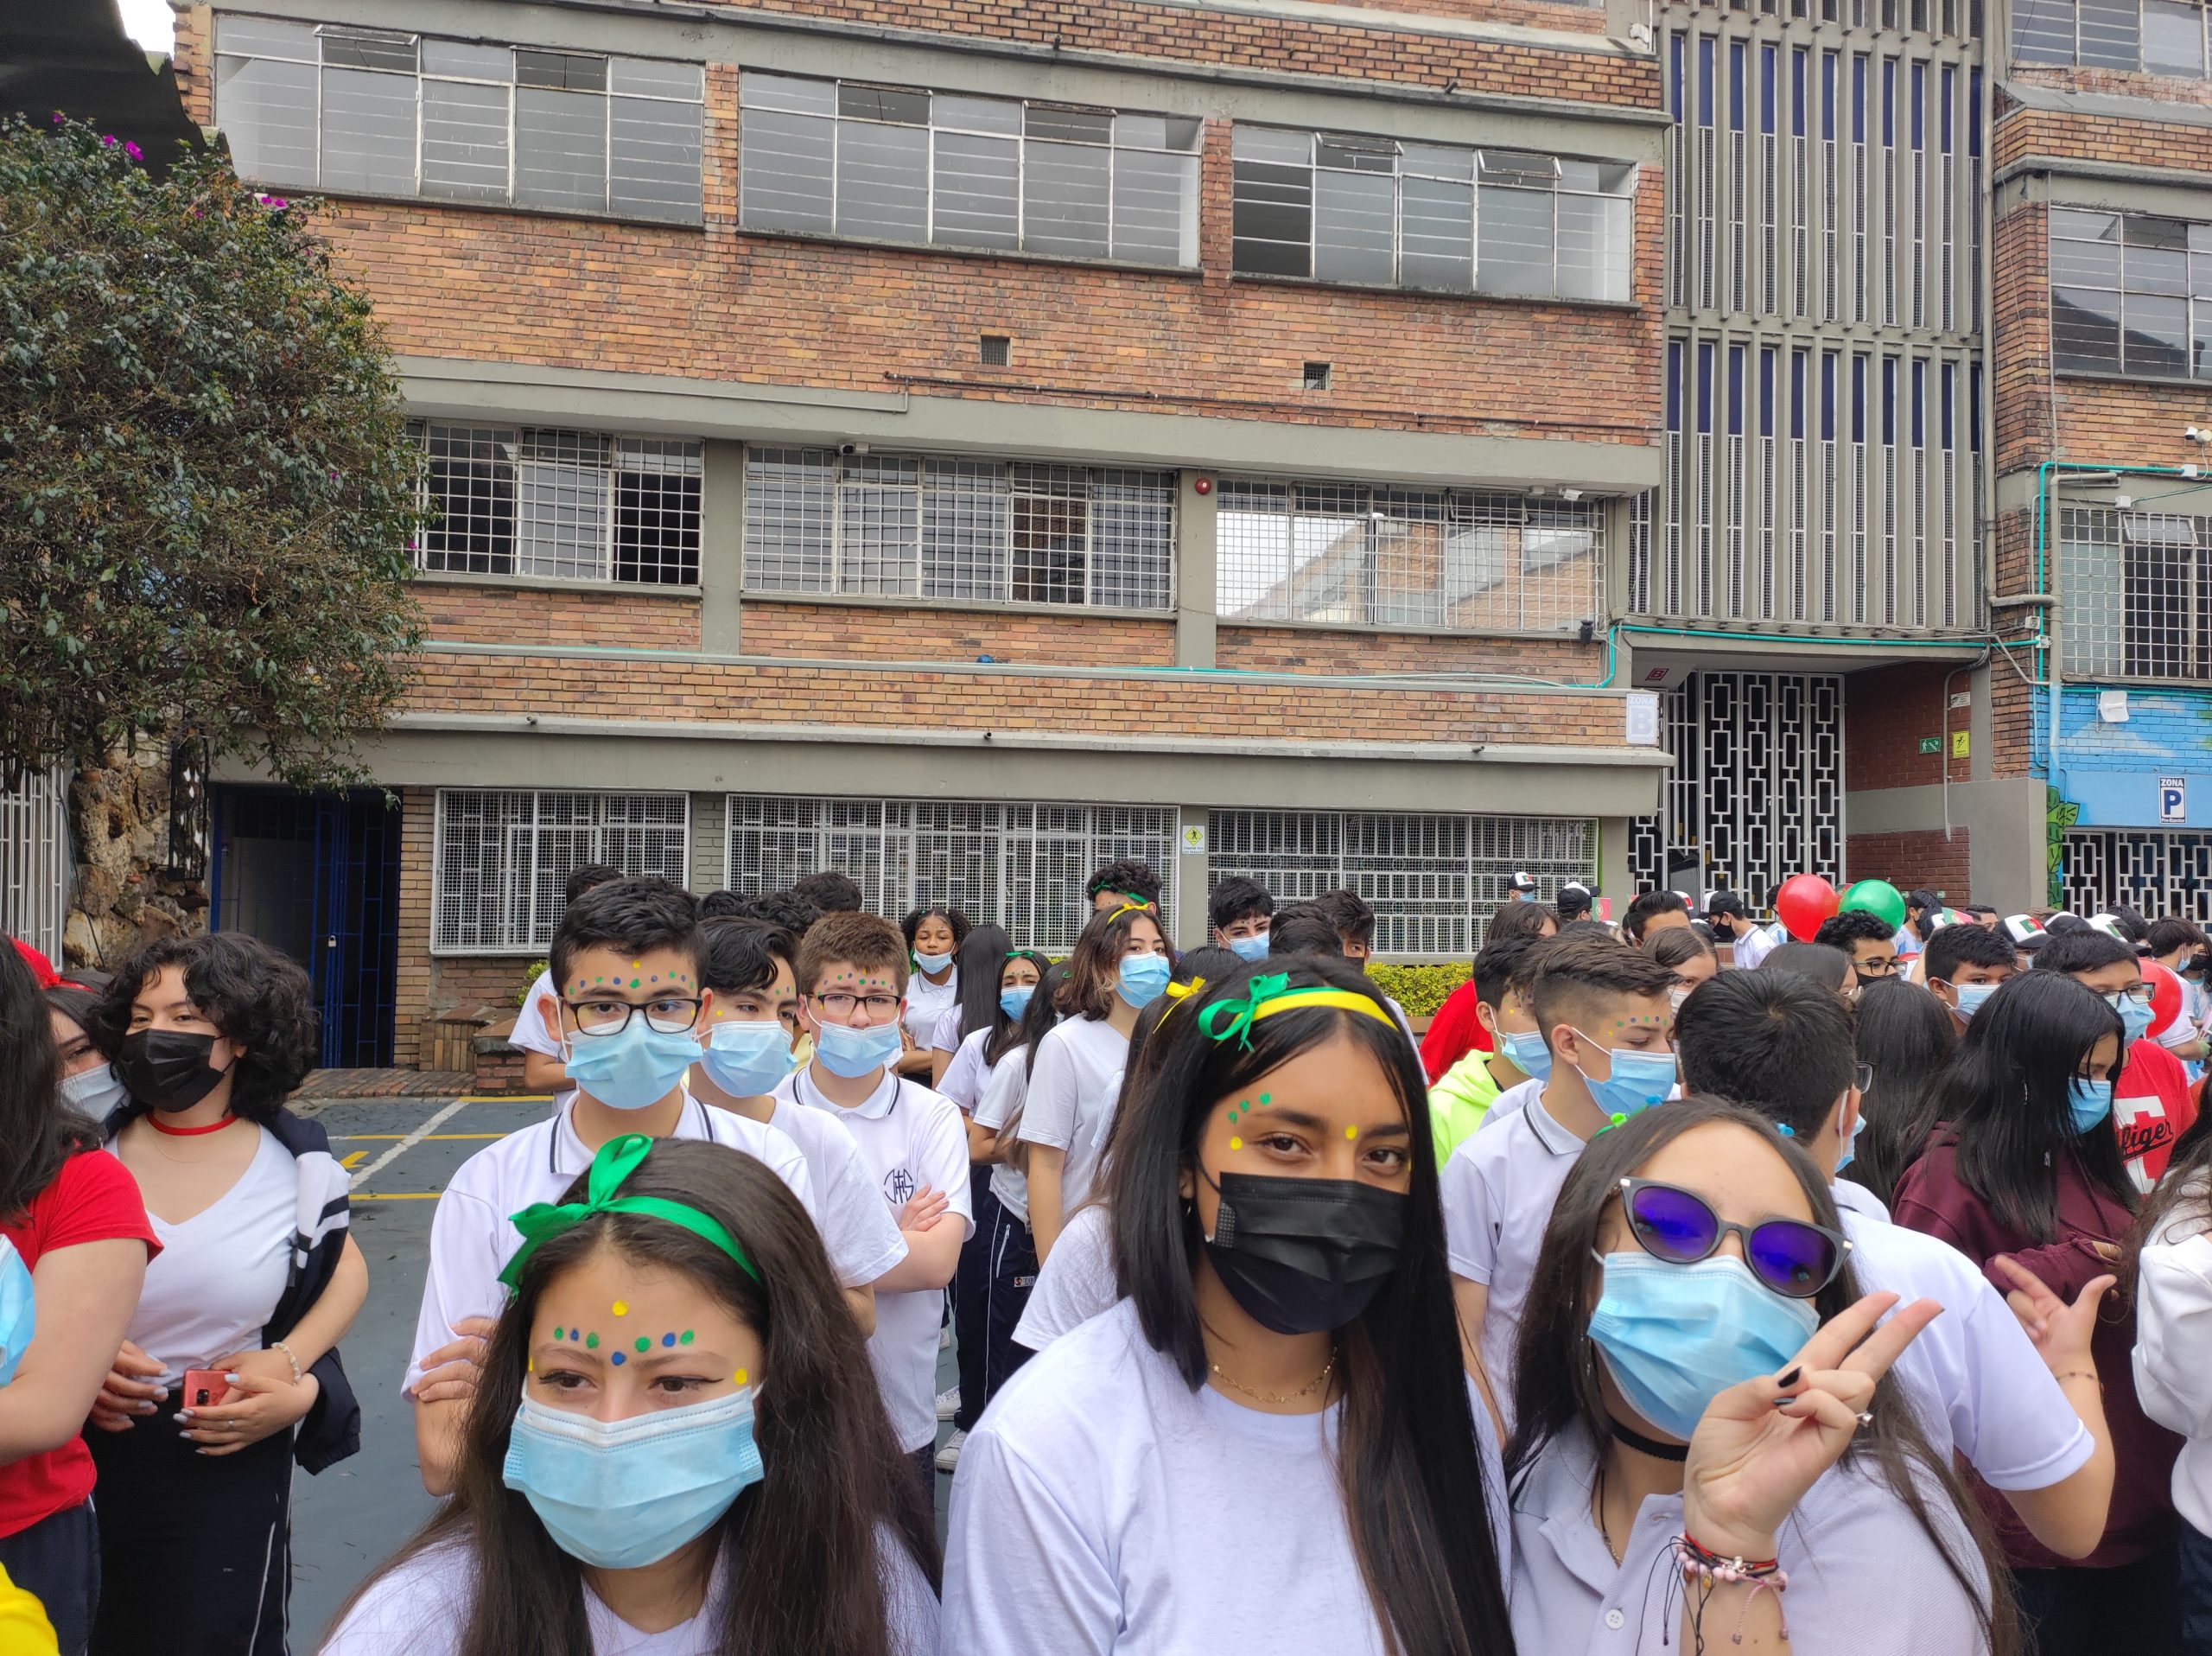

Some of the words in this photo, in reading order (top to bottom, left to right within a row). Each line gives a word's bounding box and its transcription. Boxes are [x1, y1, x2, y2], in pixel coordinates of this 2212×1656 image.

[1629, 696, 1656, 705] ZONA
[1630, 707, 1652, 735] B
[2160, 778, 2183, 787] ZONA
[2164, 790, 2182, 815] P
